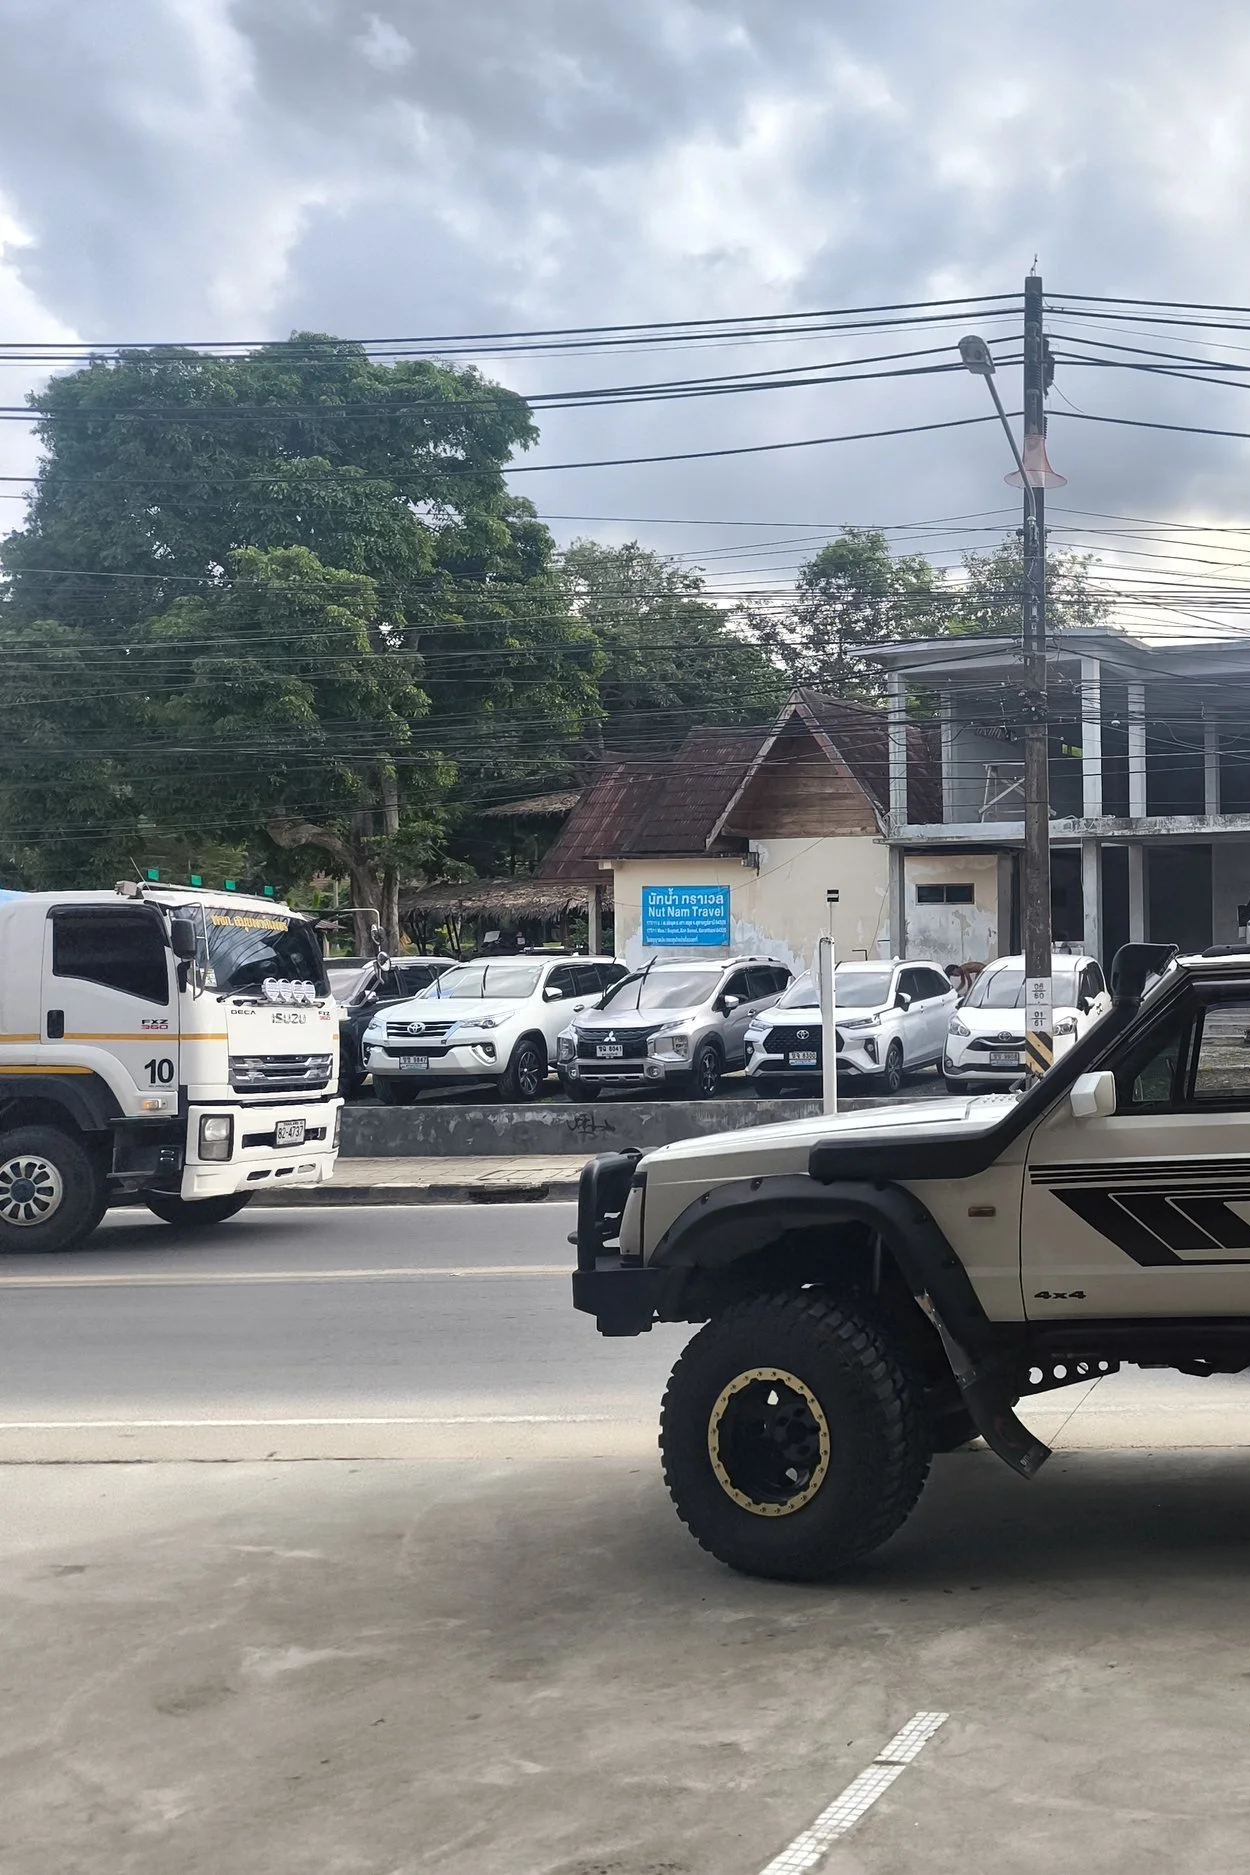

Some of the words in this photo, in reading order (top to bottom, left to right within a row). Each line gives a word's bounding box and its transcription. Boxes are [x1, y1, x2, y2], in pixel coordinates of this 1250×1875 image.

[648, 906, 666, 917] Nut
[667, 906, 690, 917] Nam
[692, 905, 724, 917] Travel
[271, 1013, 306, 1024] ISUZU
[144, 1058, 175, 1084] 10
[277, 1125, 304, 1140] 82-4737
[1034, 1290, 1087, 1300] 4x4
